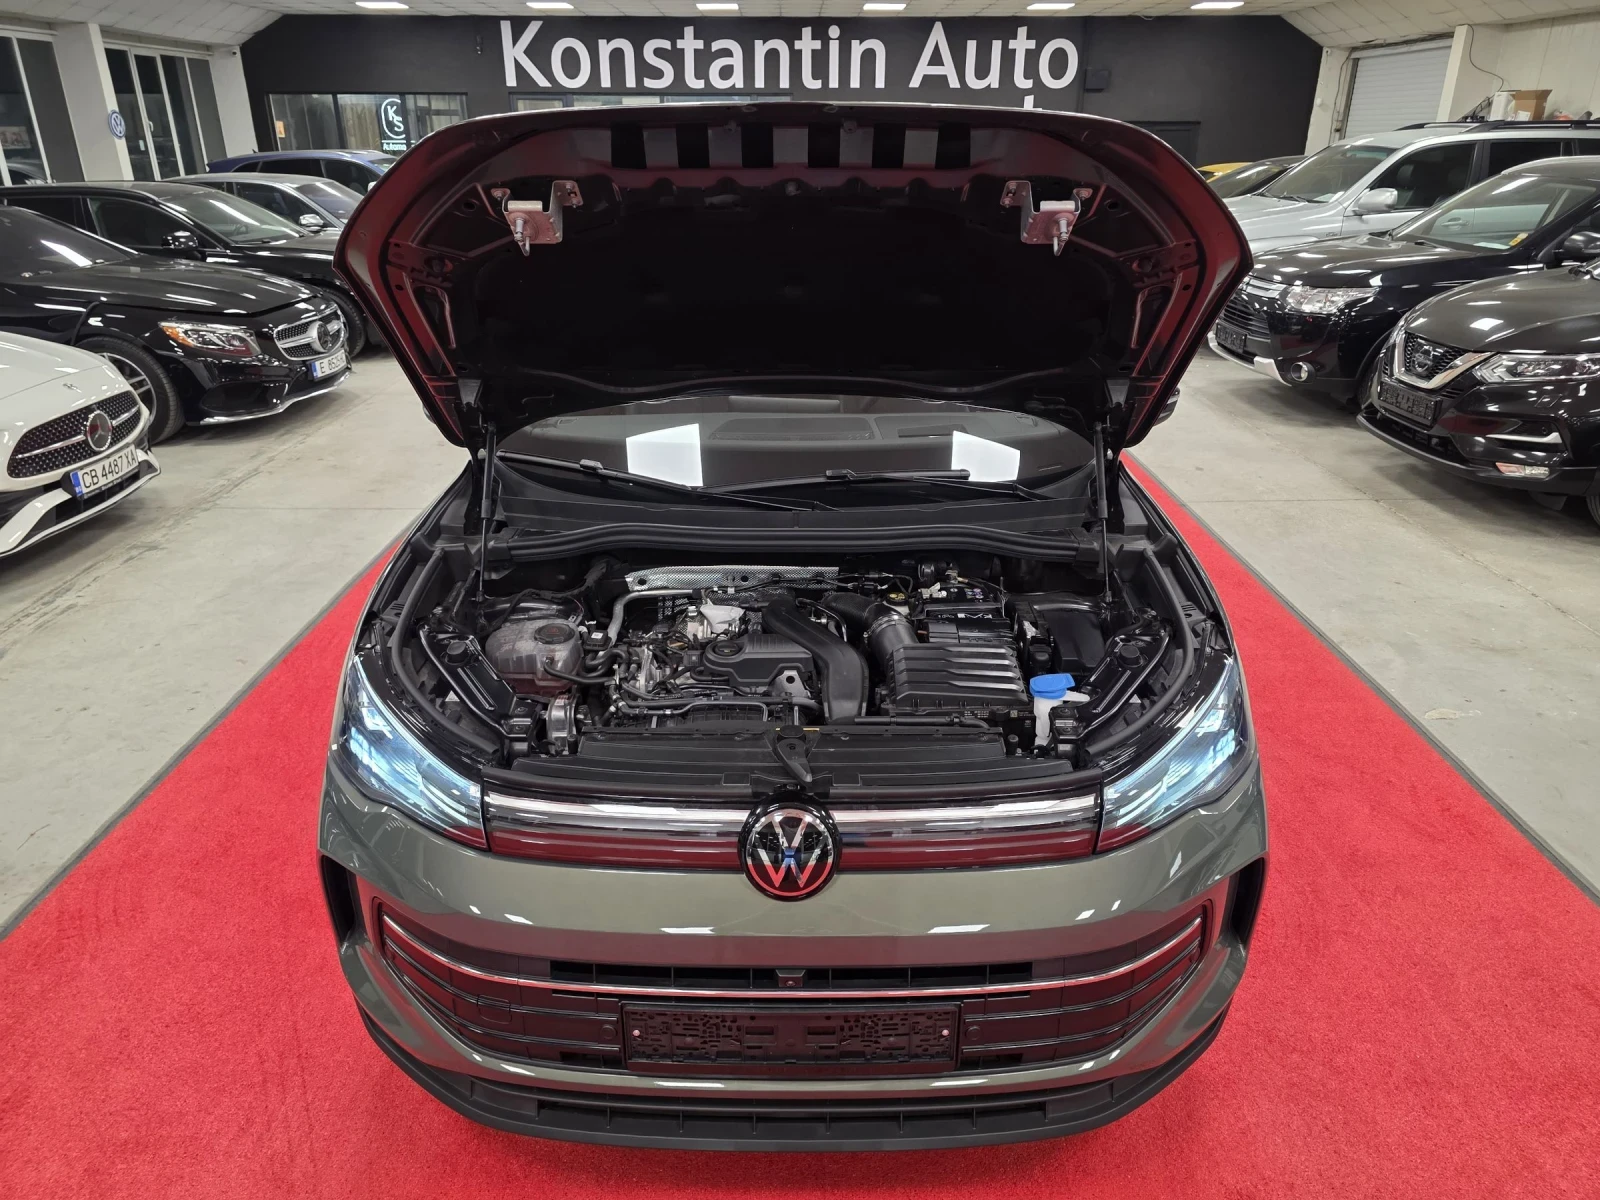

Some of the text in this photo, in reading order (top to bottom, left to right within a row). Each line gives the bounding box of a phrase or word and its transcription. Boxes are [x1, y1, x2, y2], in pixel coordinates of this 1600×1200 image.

[500, 20, 1079, 90] Konstantin Auto
[82, 468, 100, 489] CB
[101, 455, 123, 480] 4487
[124, 449, 137, 469] XA
[746, 808, 834, 897] VW
